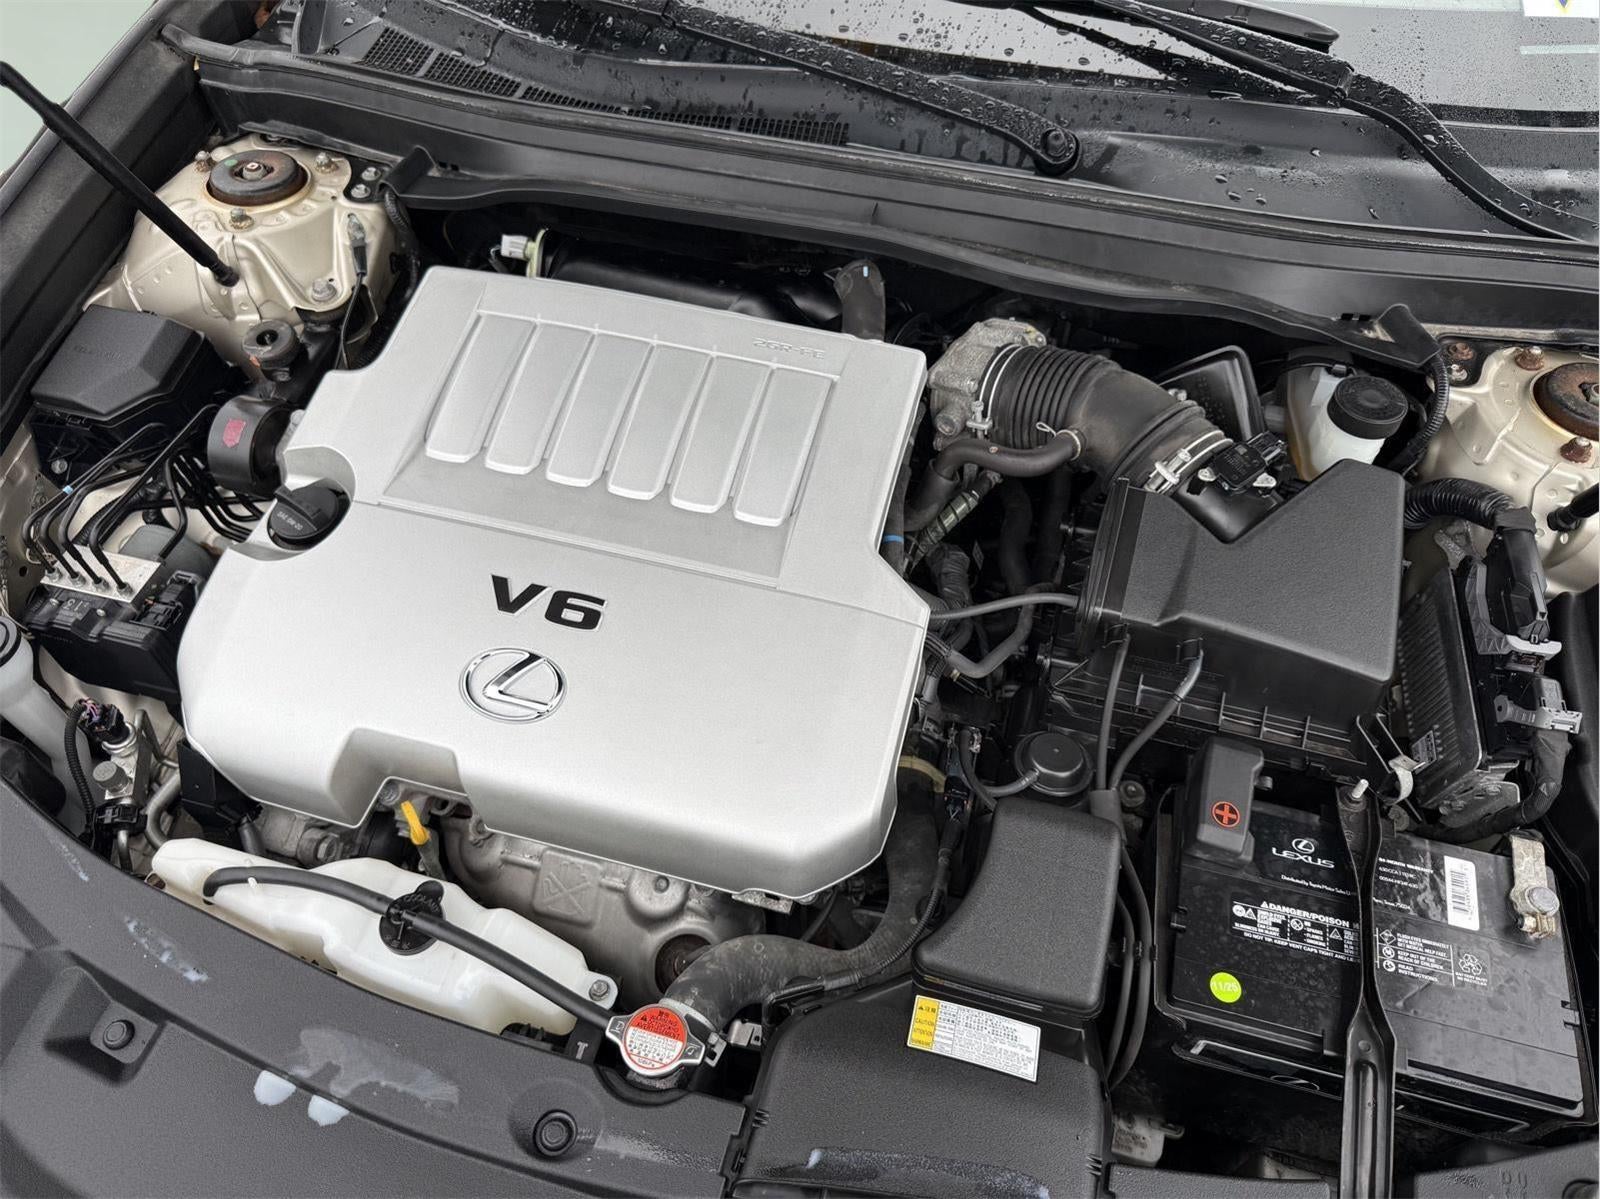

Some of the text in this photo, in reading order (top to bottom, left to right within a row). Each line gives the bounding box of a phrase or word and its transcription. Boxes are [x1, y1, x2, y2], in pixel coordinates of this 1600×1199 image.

[491, 574, 606, 630] V6
[1272, 847, 1335, 868] LEXUS
[1268, 902, 1350, 928] DANGER/POISON
